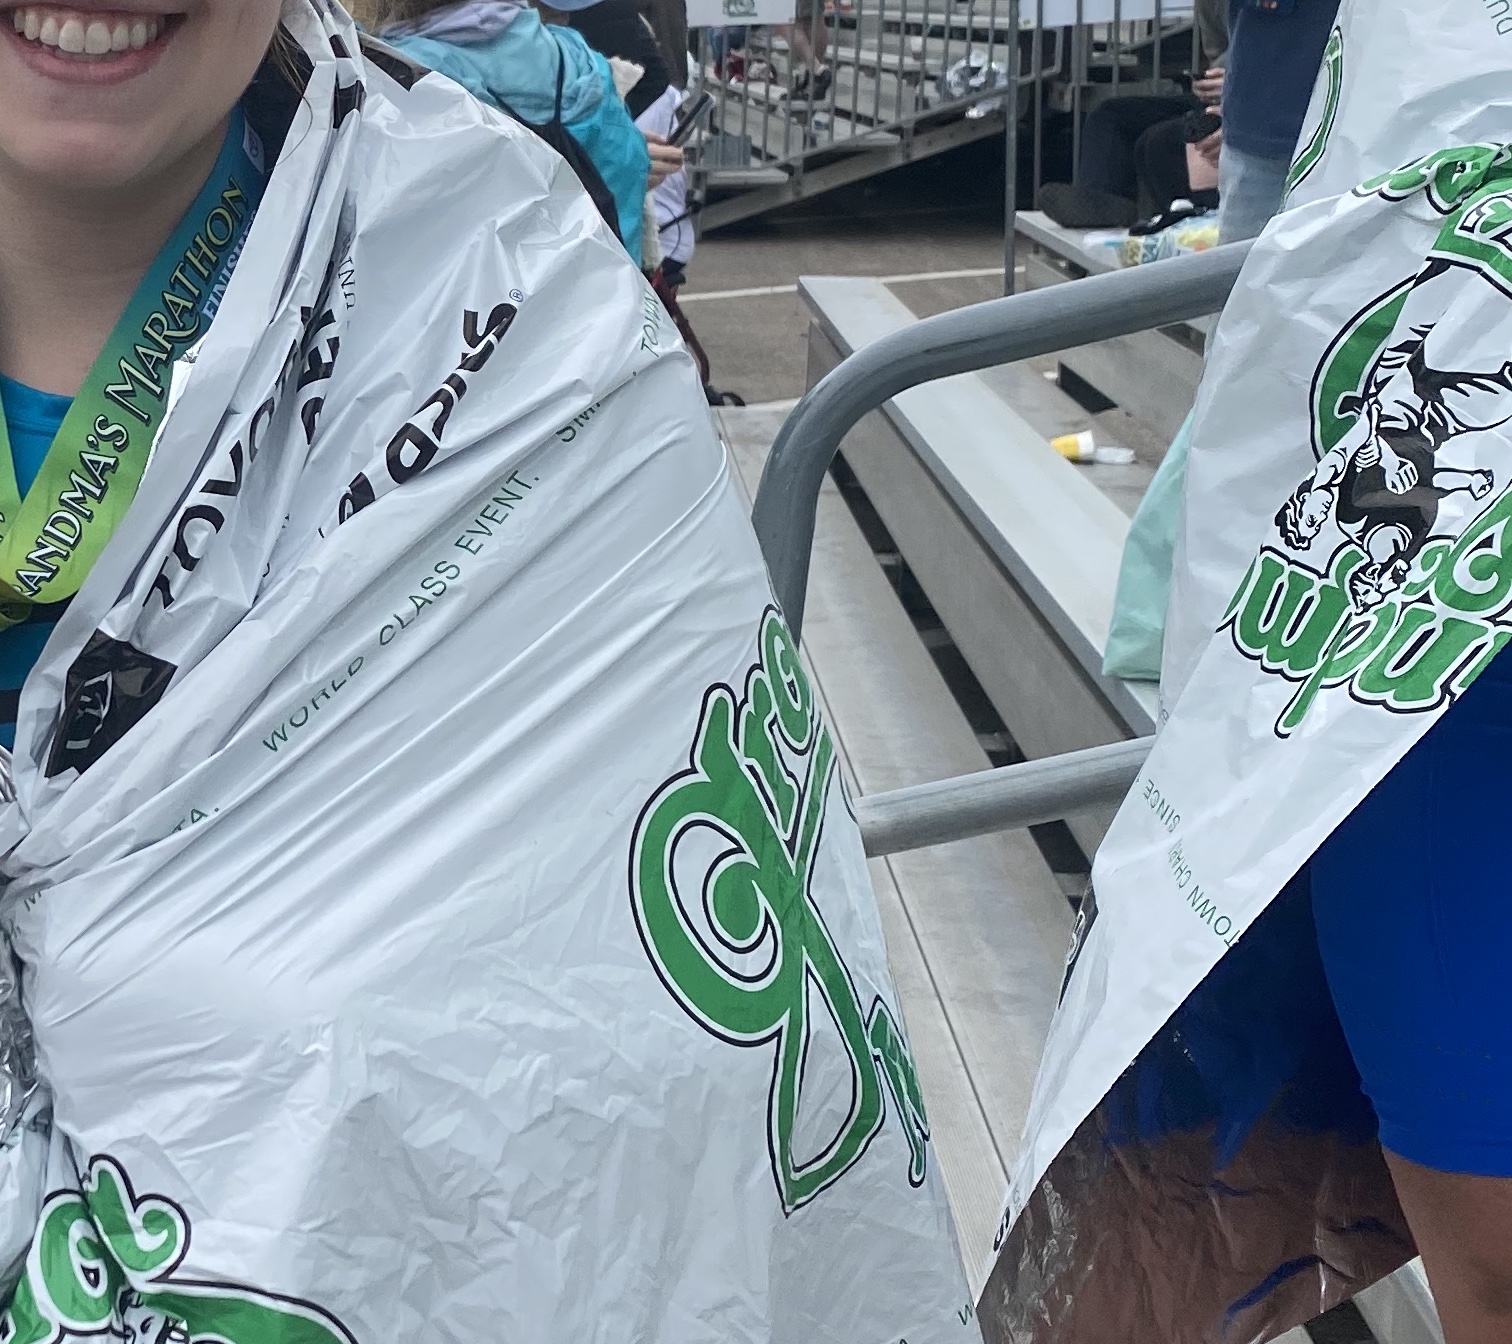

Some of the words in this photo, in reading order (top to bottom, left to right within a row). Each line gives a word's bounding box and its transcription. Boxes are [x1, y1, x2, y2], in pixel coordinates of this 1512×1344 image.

[14, 412, 131, 599] ANDMA'S
[105, 176, 248, 423] MARATHON
[262, 655, 365, 752] WORLD
[379, 560, 461, 646] CLASS
[454, 469, 540, 556] EVENT.
